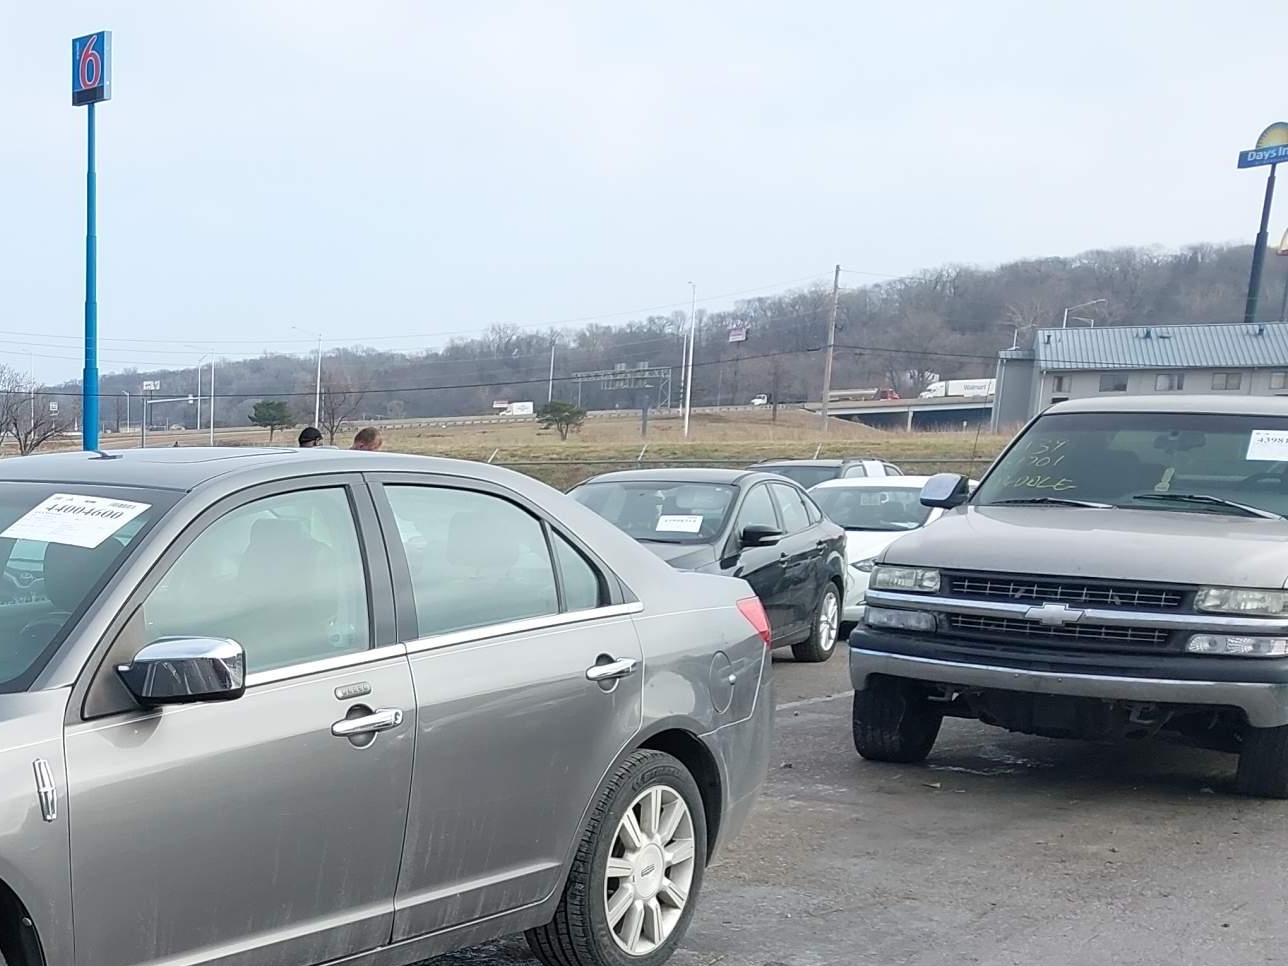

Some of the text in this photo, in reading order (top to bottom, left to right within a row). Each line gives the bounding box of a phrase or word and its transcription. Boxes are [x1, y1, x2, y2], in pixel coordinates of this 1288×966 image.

[79, 35, 102, 89] 6
[1247, 150, 1277, 161] Days
[46, 503, 124, 519] 44004600
